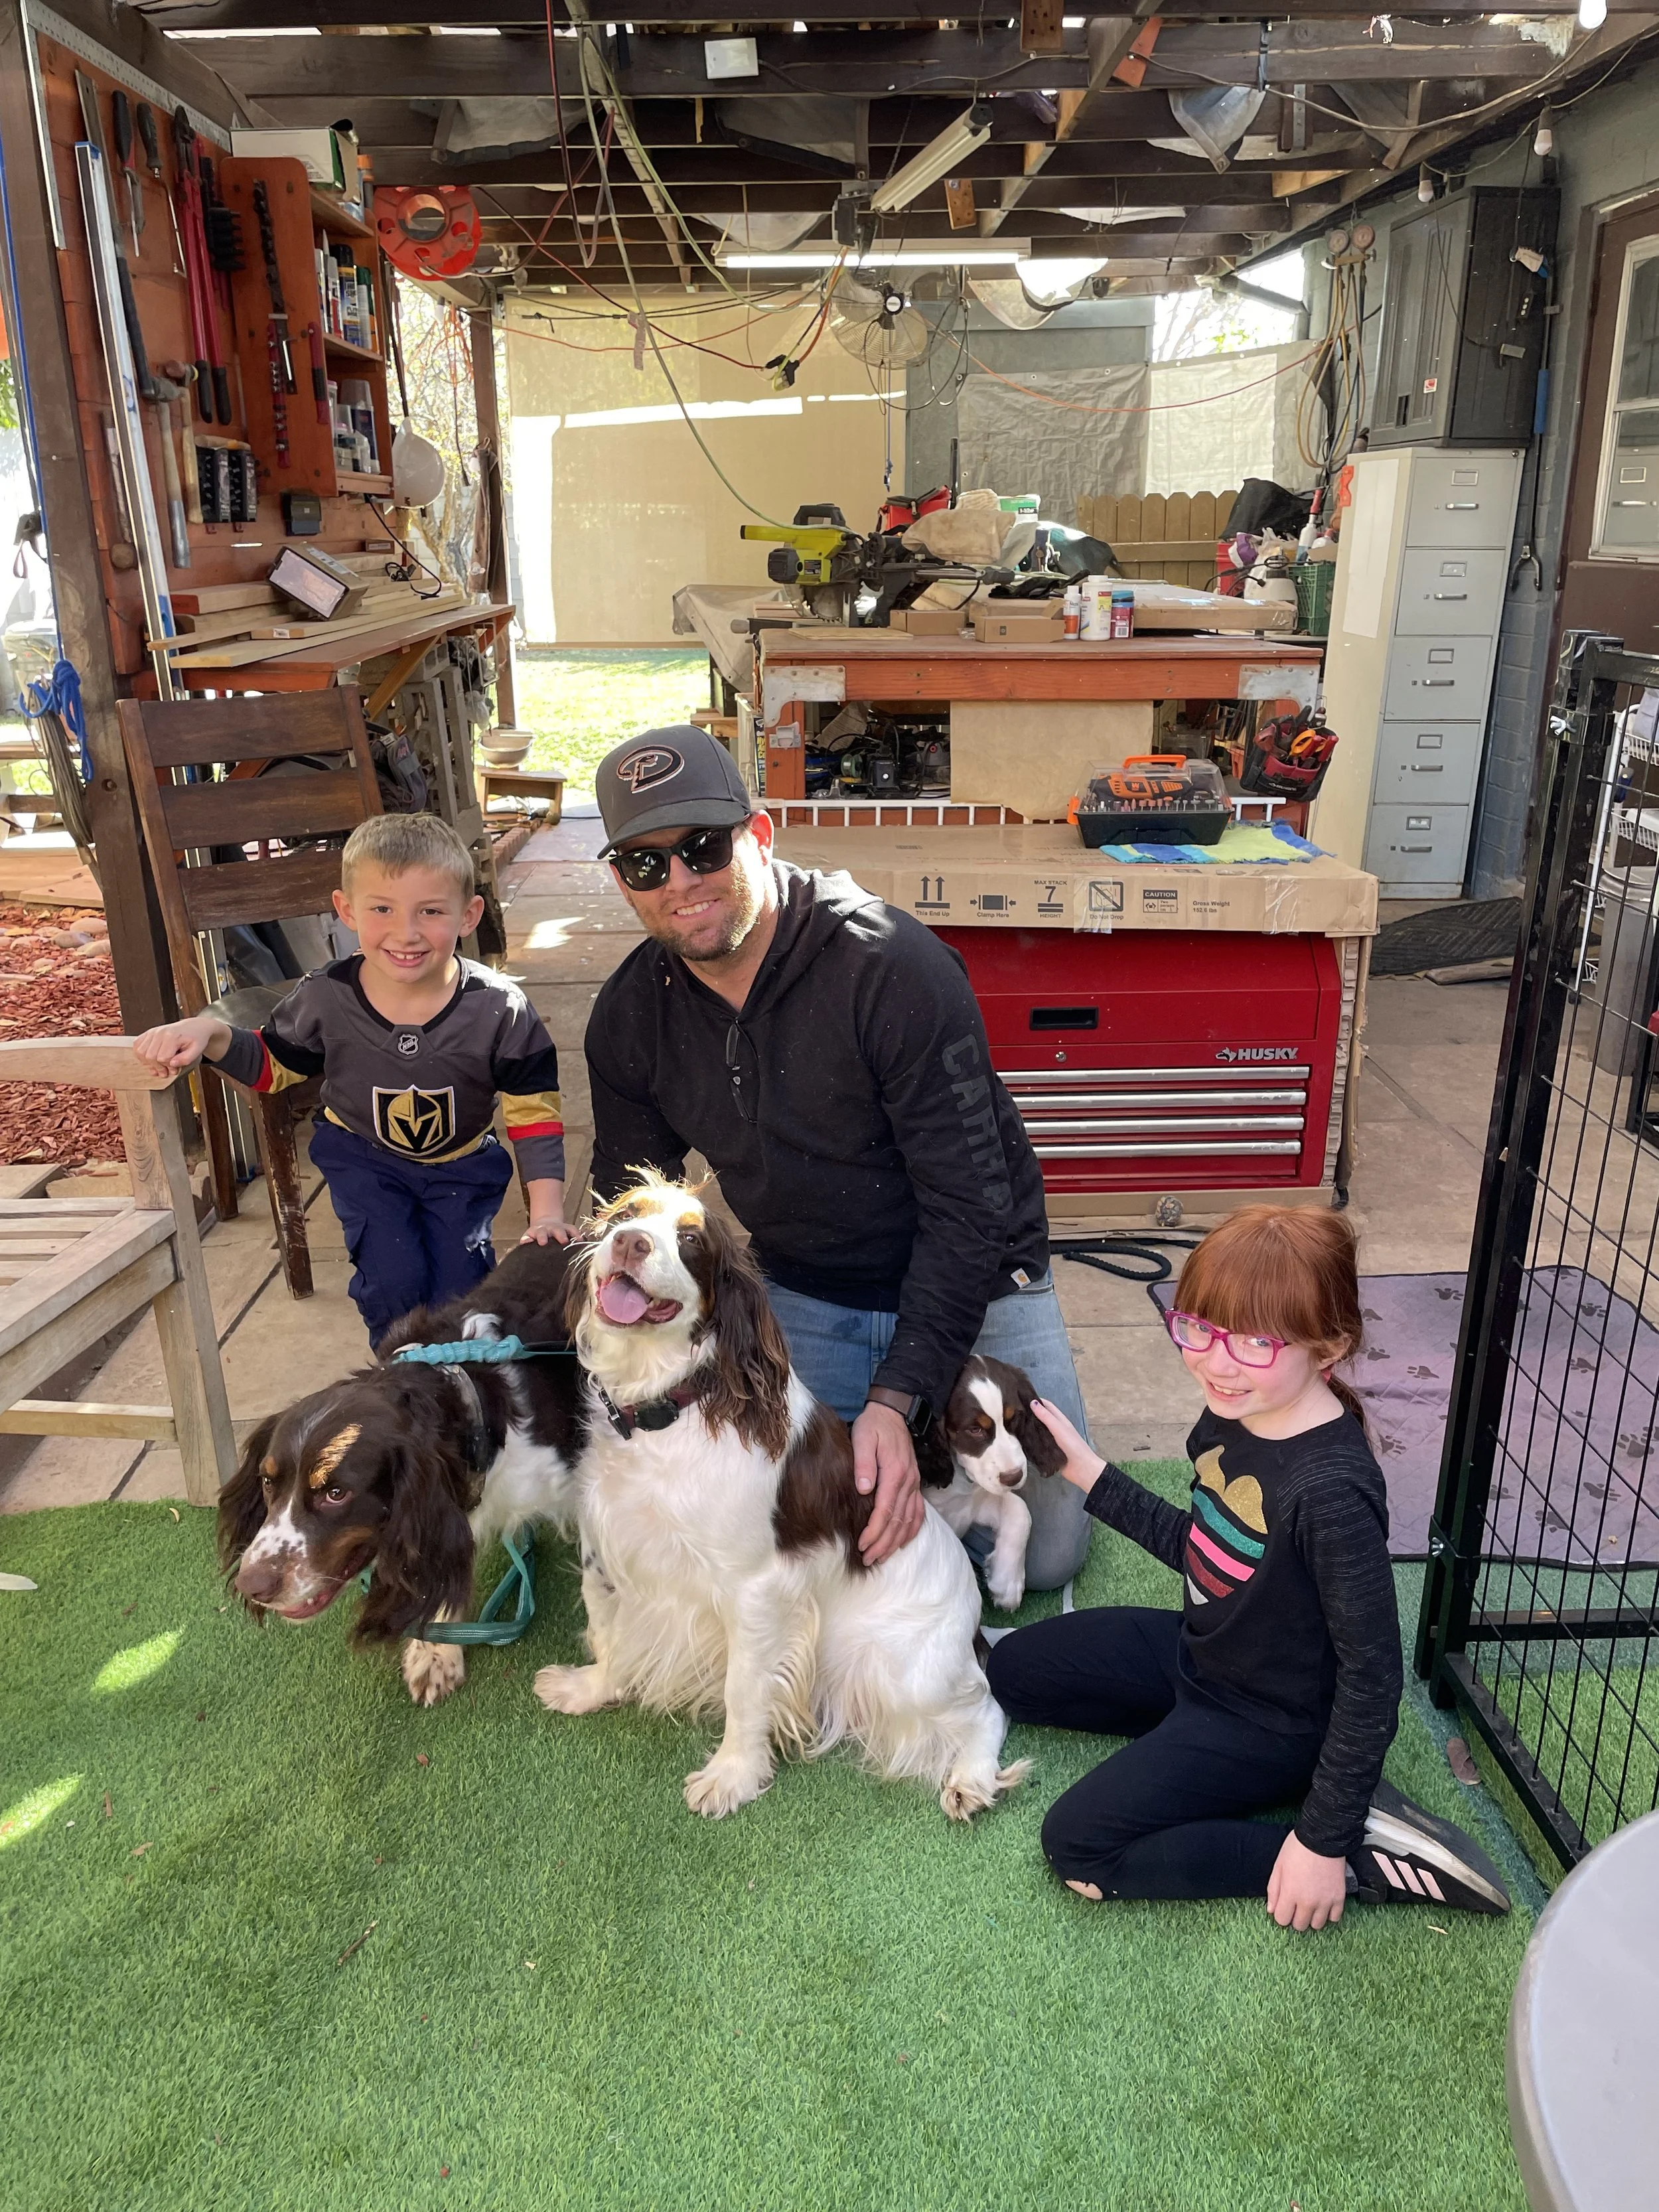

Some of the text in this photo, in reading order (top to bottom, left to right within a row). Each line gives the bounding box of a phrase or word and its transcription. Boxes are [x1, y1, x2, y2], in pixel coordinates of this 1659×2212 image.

[1045, 885, 1056, 903] 7
[402, 1039, 414, 1050] NHL
[1237, 1047, 1299, 1061] HUSKY
